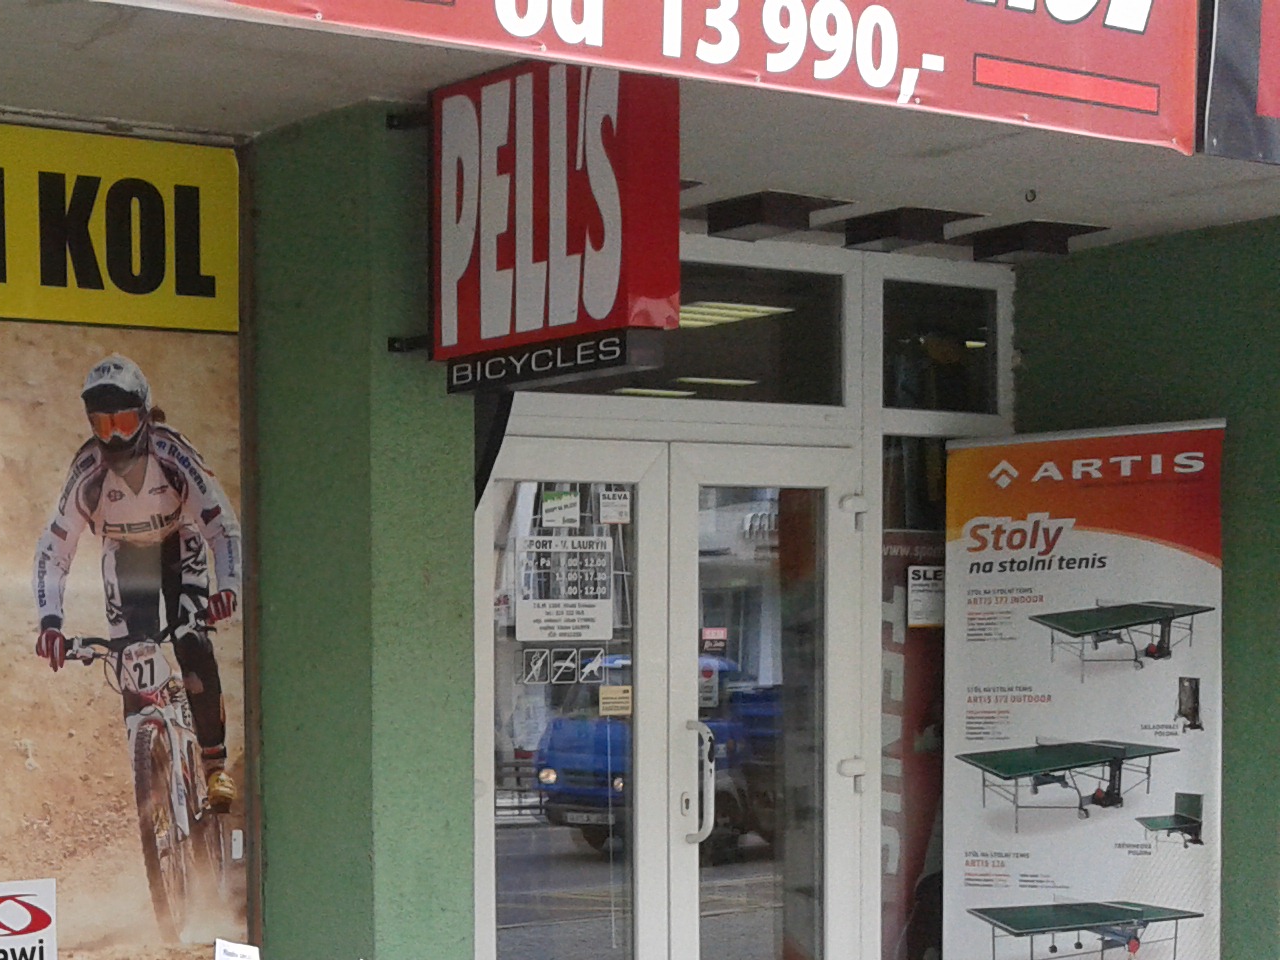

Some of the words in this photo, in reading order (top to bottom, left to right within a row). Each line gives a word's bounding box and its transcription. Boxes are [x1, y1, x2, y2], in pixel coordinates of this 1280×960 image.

[440, 64, 622, 347] PELL'S
[38, 171, 217, 298] KOL
[451, 336, 622, 387] BICYCLES
[1030, 451, 1205, 483] ARTIS
[966, 519, 1064, 556] Stoly
[911, 569, 944, 581] SLE
[969, 560, 993, 574] na
[997, 554, 1056, 573] stolní
[1057, 553, 1107, 571] tenis
[133, 659, 155, 689] 27
